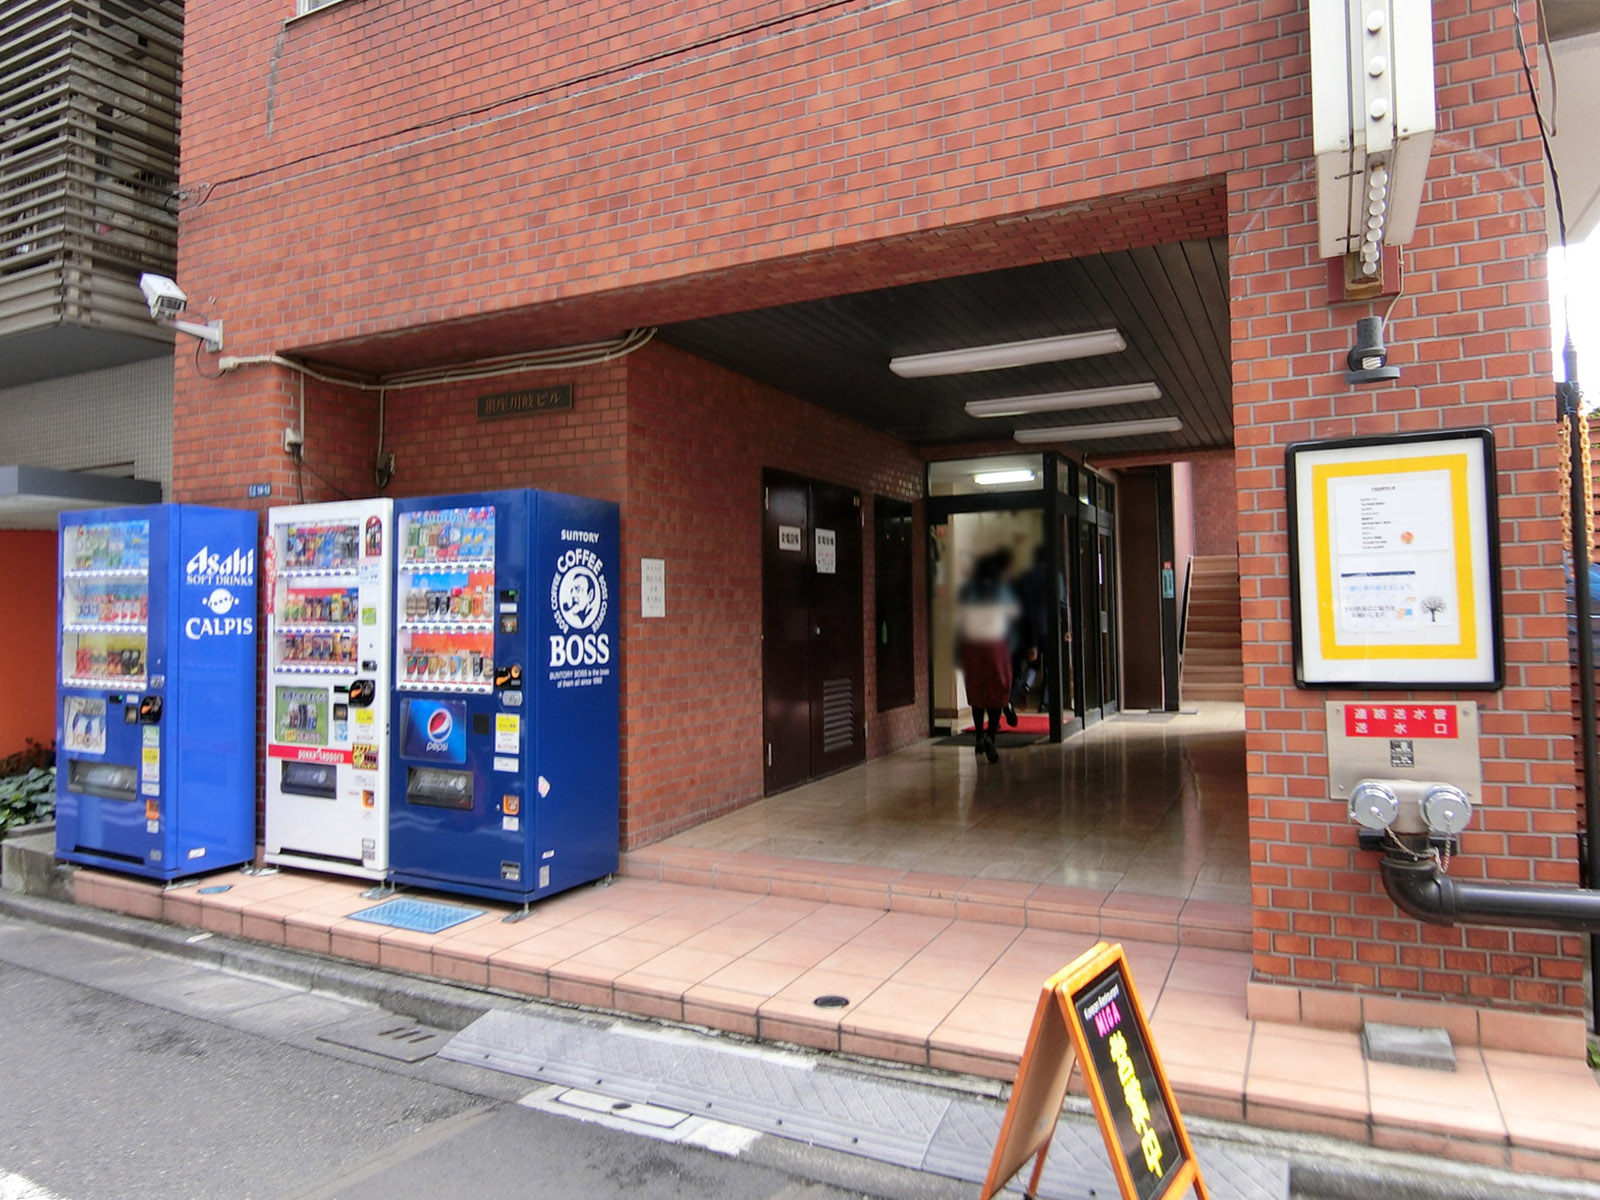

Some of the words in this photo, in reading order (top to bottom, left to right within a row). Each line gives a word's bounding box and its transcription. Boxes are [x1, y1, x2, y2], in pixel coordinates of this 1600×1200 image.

[561, 529, 599, 543] SUNTORY
[186, 545, 254, 577] Asahi
[557, 548, 603, 576] COFFEE
[186, 575, 212, 586] SOFT
[216, 575, 254, 586] DRINKS
[185, 617, 253, 640] CALPIS
[549, 633, 610, 667] BOSS
[1354, 707, 1447, 720] 連結送水管
[1354, 721, 1448, 734] 送水口
[426, 742, 449, 752] pepsi
[1094, 1000, 1122, 1038] MIGA
[1108, 1029, 1164, 1179] 営業中
